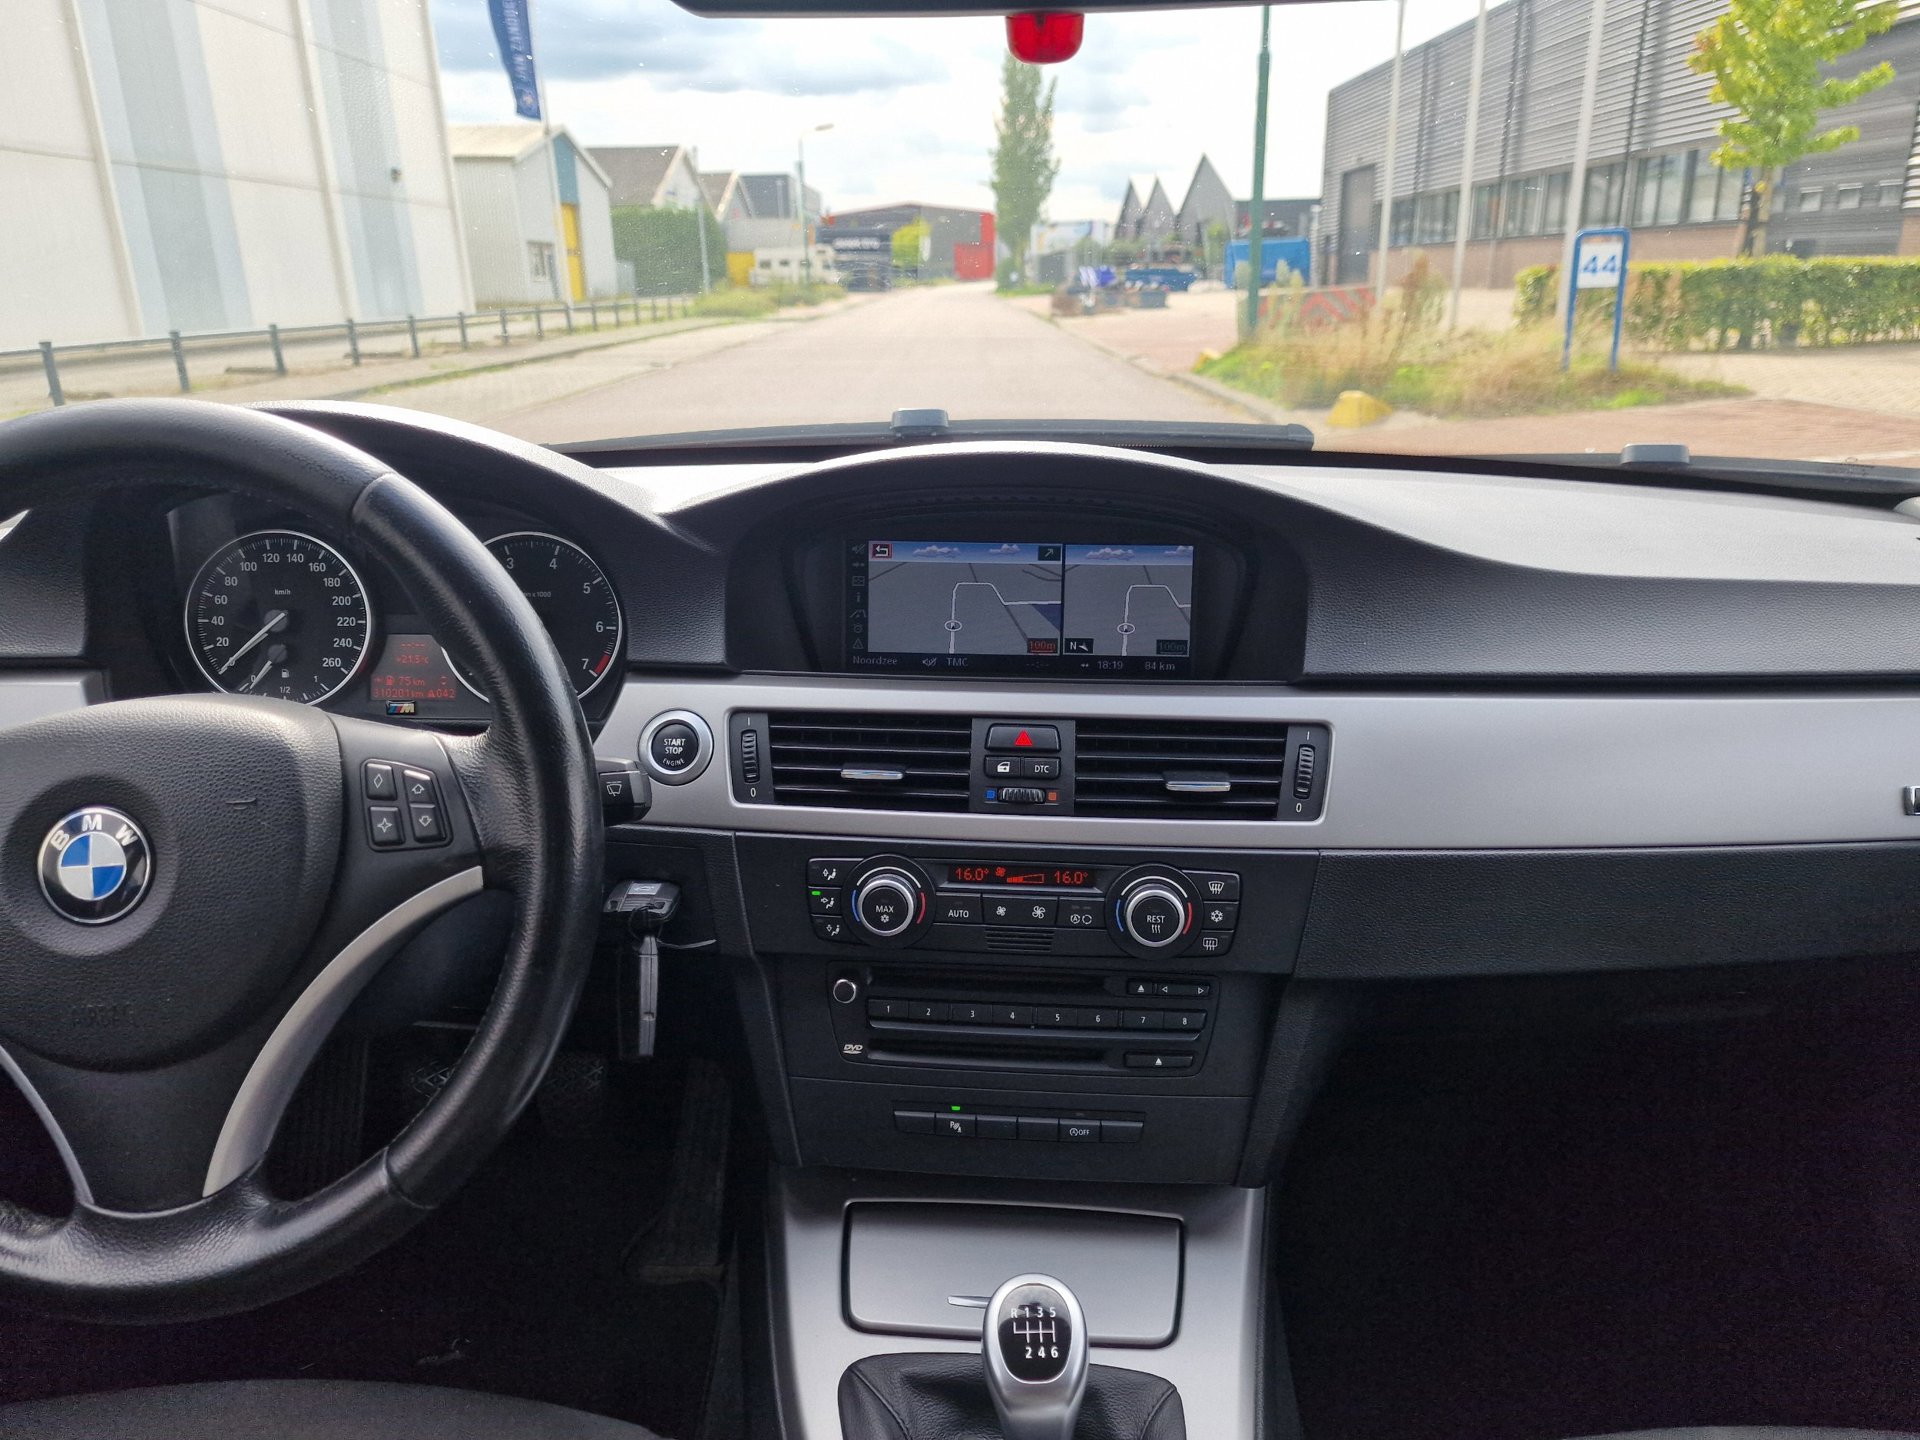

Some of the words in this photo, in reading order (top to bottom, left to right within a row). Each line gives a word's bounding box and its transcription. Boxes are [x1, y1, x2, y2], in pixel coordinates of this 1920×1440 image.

[1583, 255, 1617, 273] 44
[262, 554, 280, 562] 120
[286, 554, 304, 562] 140
[240, 562, 257, 572] 100
[309, 562, 326, 572] 160
[506, 558, 514, 569] 3
[550, 558, 558, 569] 4
[224, 576, 238, 586] 80
[323, 577, 340, 588] 180
[584, 582, 591, 594] 5
[214, 595, 228, 604] 60
[332, 596, 351, 606] 200
[211, 616, 224, 625] 40
[337, 616, 356, 626] 220
[596, 621, 604, 632] 6
[216, 637, 230, 646] 20
[333, 638, 352, 648] 240
[1070, 642, 1076, 650] N
[322, 658, 342, 667] 260
[582, 658, 590, 670] 7
[852, 656, 898, 665] Noordzee
[946, 658, 968, 666] TMC
[1097, 661, 1124, 670] 18:19
[1144, 662, 1156, 670] 84
[1160, 662, 1176, 671] km
[665, 746, 684, 754] STOP
[662, 758, 685, 766] ENGINE
[1034, 764, 1050, 774] DTC
[750, 788, 756, 798] 0
[1296, 802, 1302, 812] 0
[50, 814, 138, 850] BMW
[948, 910, 969, 918] AUTO
[1146, 916, 1166, 924] REST
[886, 1005, 890, 1013] 1
[970, 1010, 975, 1018] 3
[1010, 1012, 1015, 1020] 4
[1096, 1014, 1100, 1022] 6
[1182, 1018, 1187, 1026] 8
[1010, 1308, 1018, 1318] R
[1024, 1308, 1030, 1318] 1
[1037, 1307, 1044, 1318] 3
[1050, 1307, 1056, 1318] 5
[1025, 1346, 1032, 1358] 2
[1038, 1346, 1046, 1358] 4
[1050, 1346, 1058, 1358] 6
